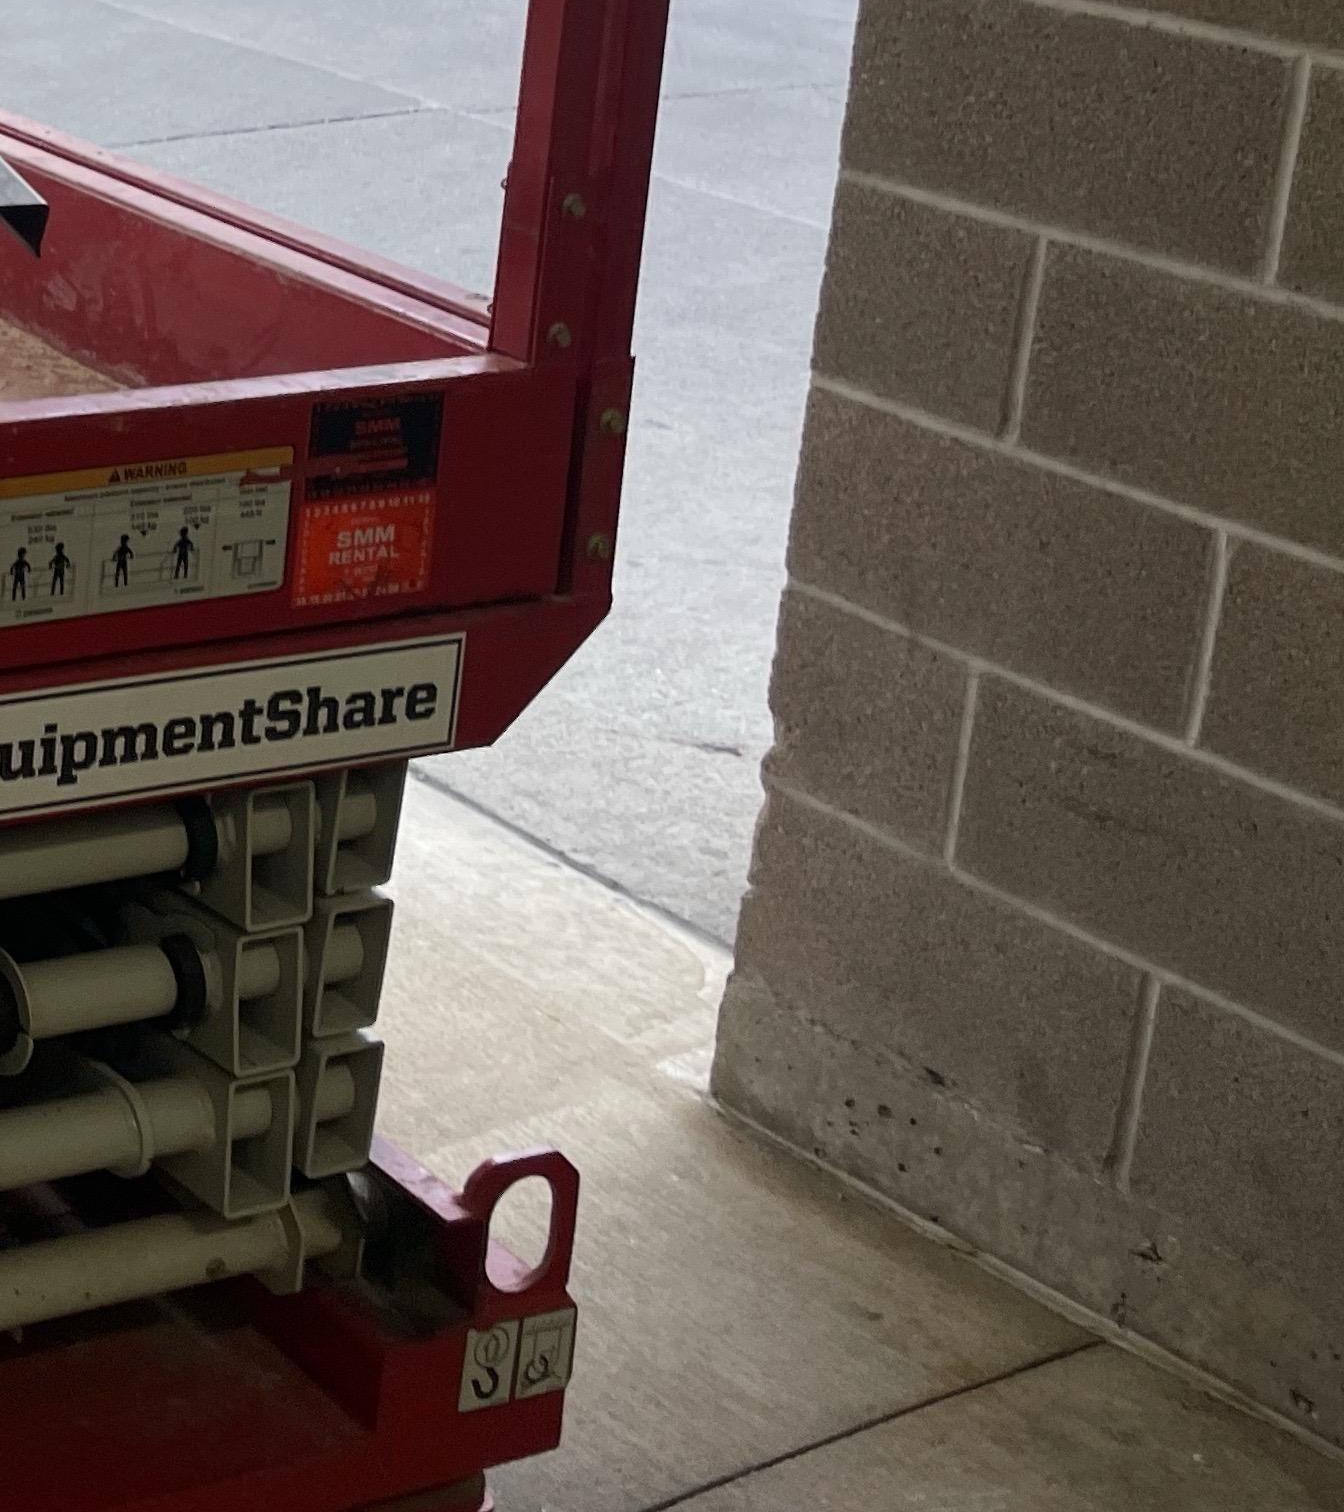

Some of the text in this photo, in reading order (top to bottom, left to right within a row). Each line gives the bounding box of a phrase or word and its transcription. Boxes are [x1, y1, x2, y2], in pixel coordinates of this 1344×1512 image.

[124, 462, 187, 482] WARNING
[337, 523, 395, 548] SMM
[329, 544, 400, 565] RENTAL
